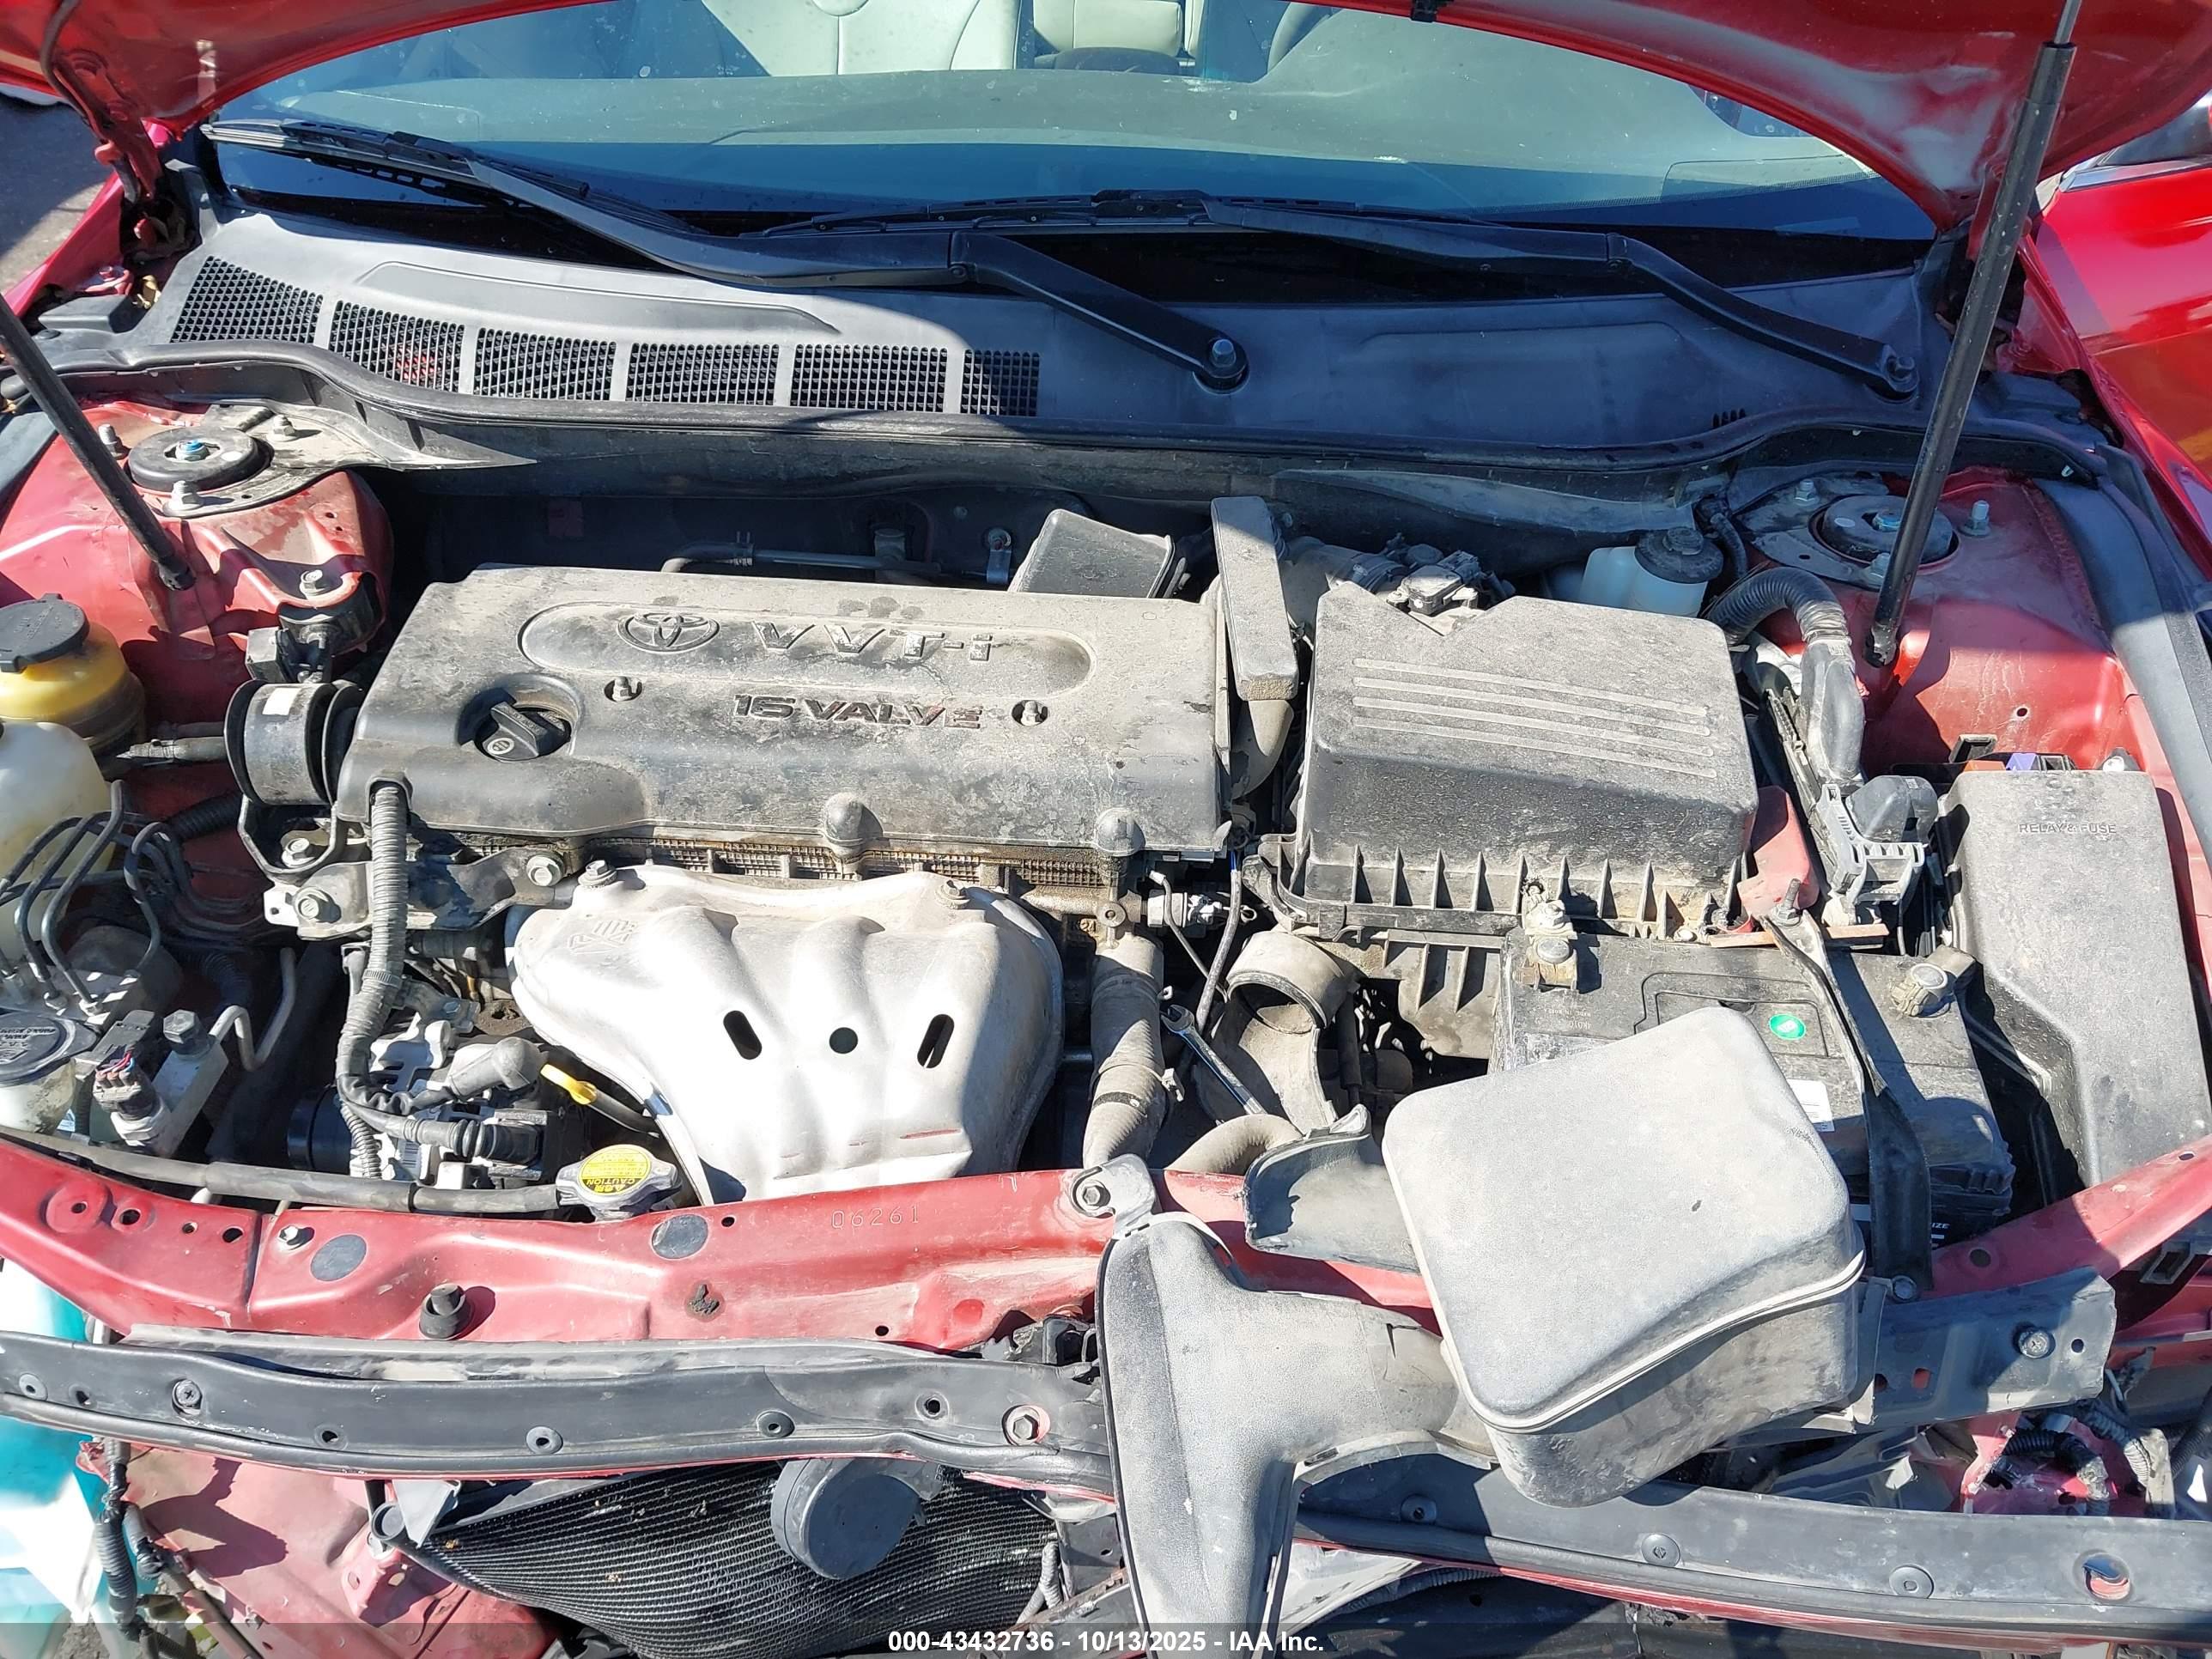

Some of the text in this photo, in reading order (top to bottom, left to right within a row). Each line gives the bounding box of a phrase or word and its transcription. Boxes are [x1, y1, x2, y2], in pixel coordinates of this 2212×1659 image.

[751, 621, 994, 662] VVT-i
[734, 694, 984, 730] 16 VALVE
[2018, 823, 2117, 834] RELAY & FUSE
